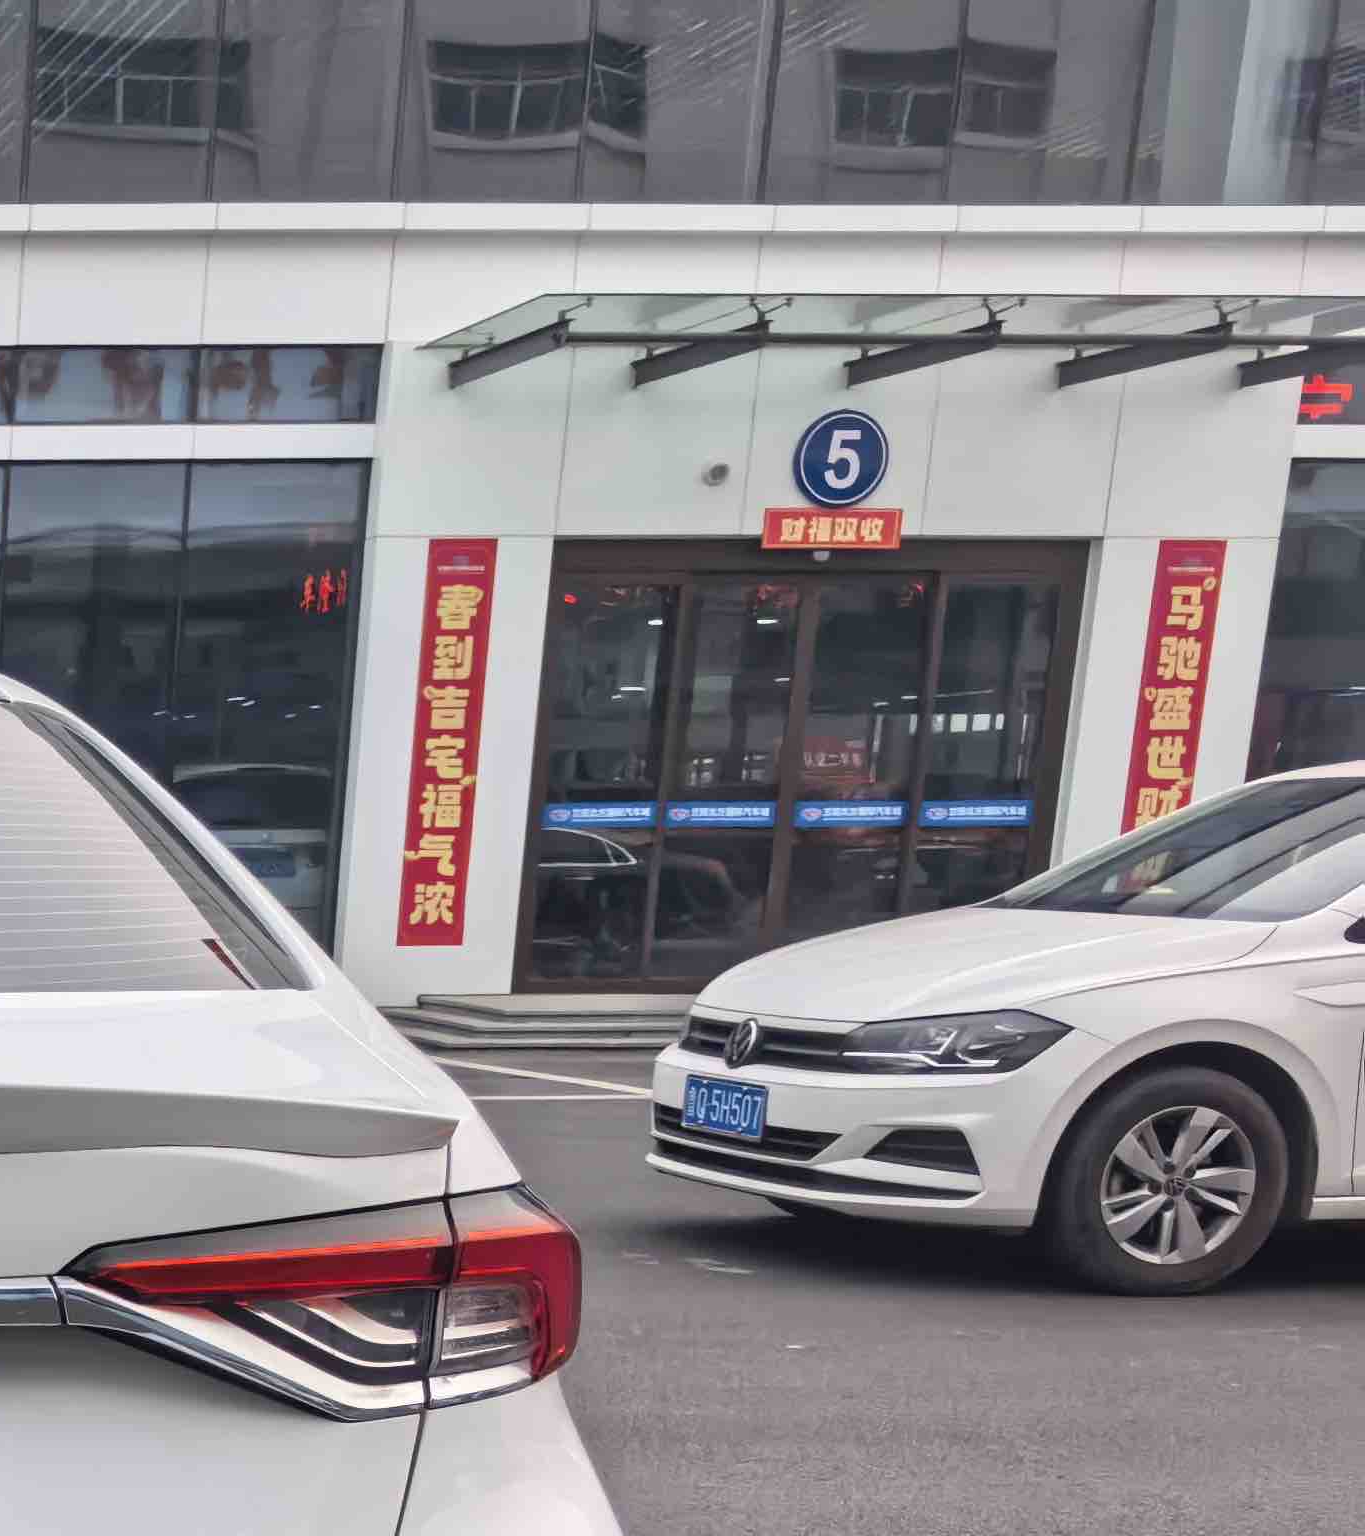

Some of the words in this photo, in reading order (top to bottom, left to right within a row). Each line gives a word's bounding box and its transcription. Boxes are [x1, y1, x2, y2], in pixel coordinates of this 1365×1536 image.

[824, 429, 862, 489] 5
[780, 517, 885, 542] 财福双收
[405, 584, 485, 925] 春到吉宅福气浓
